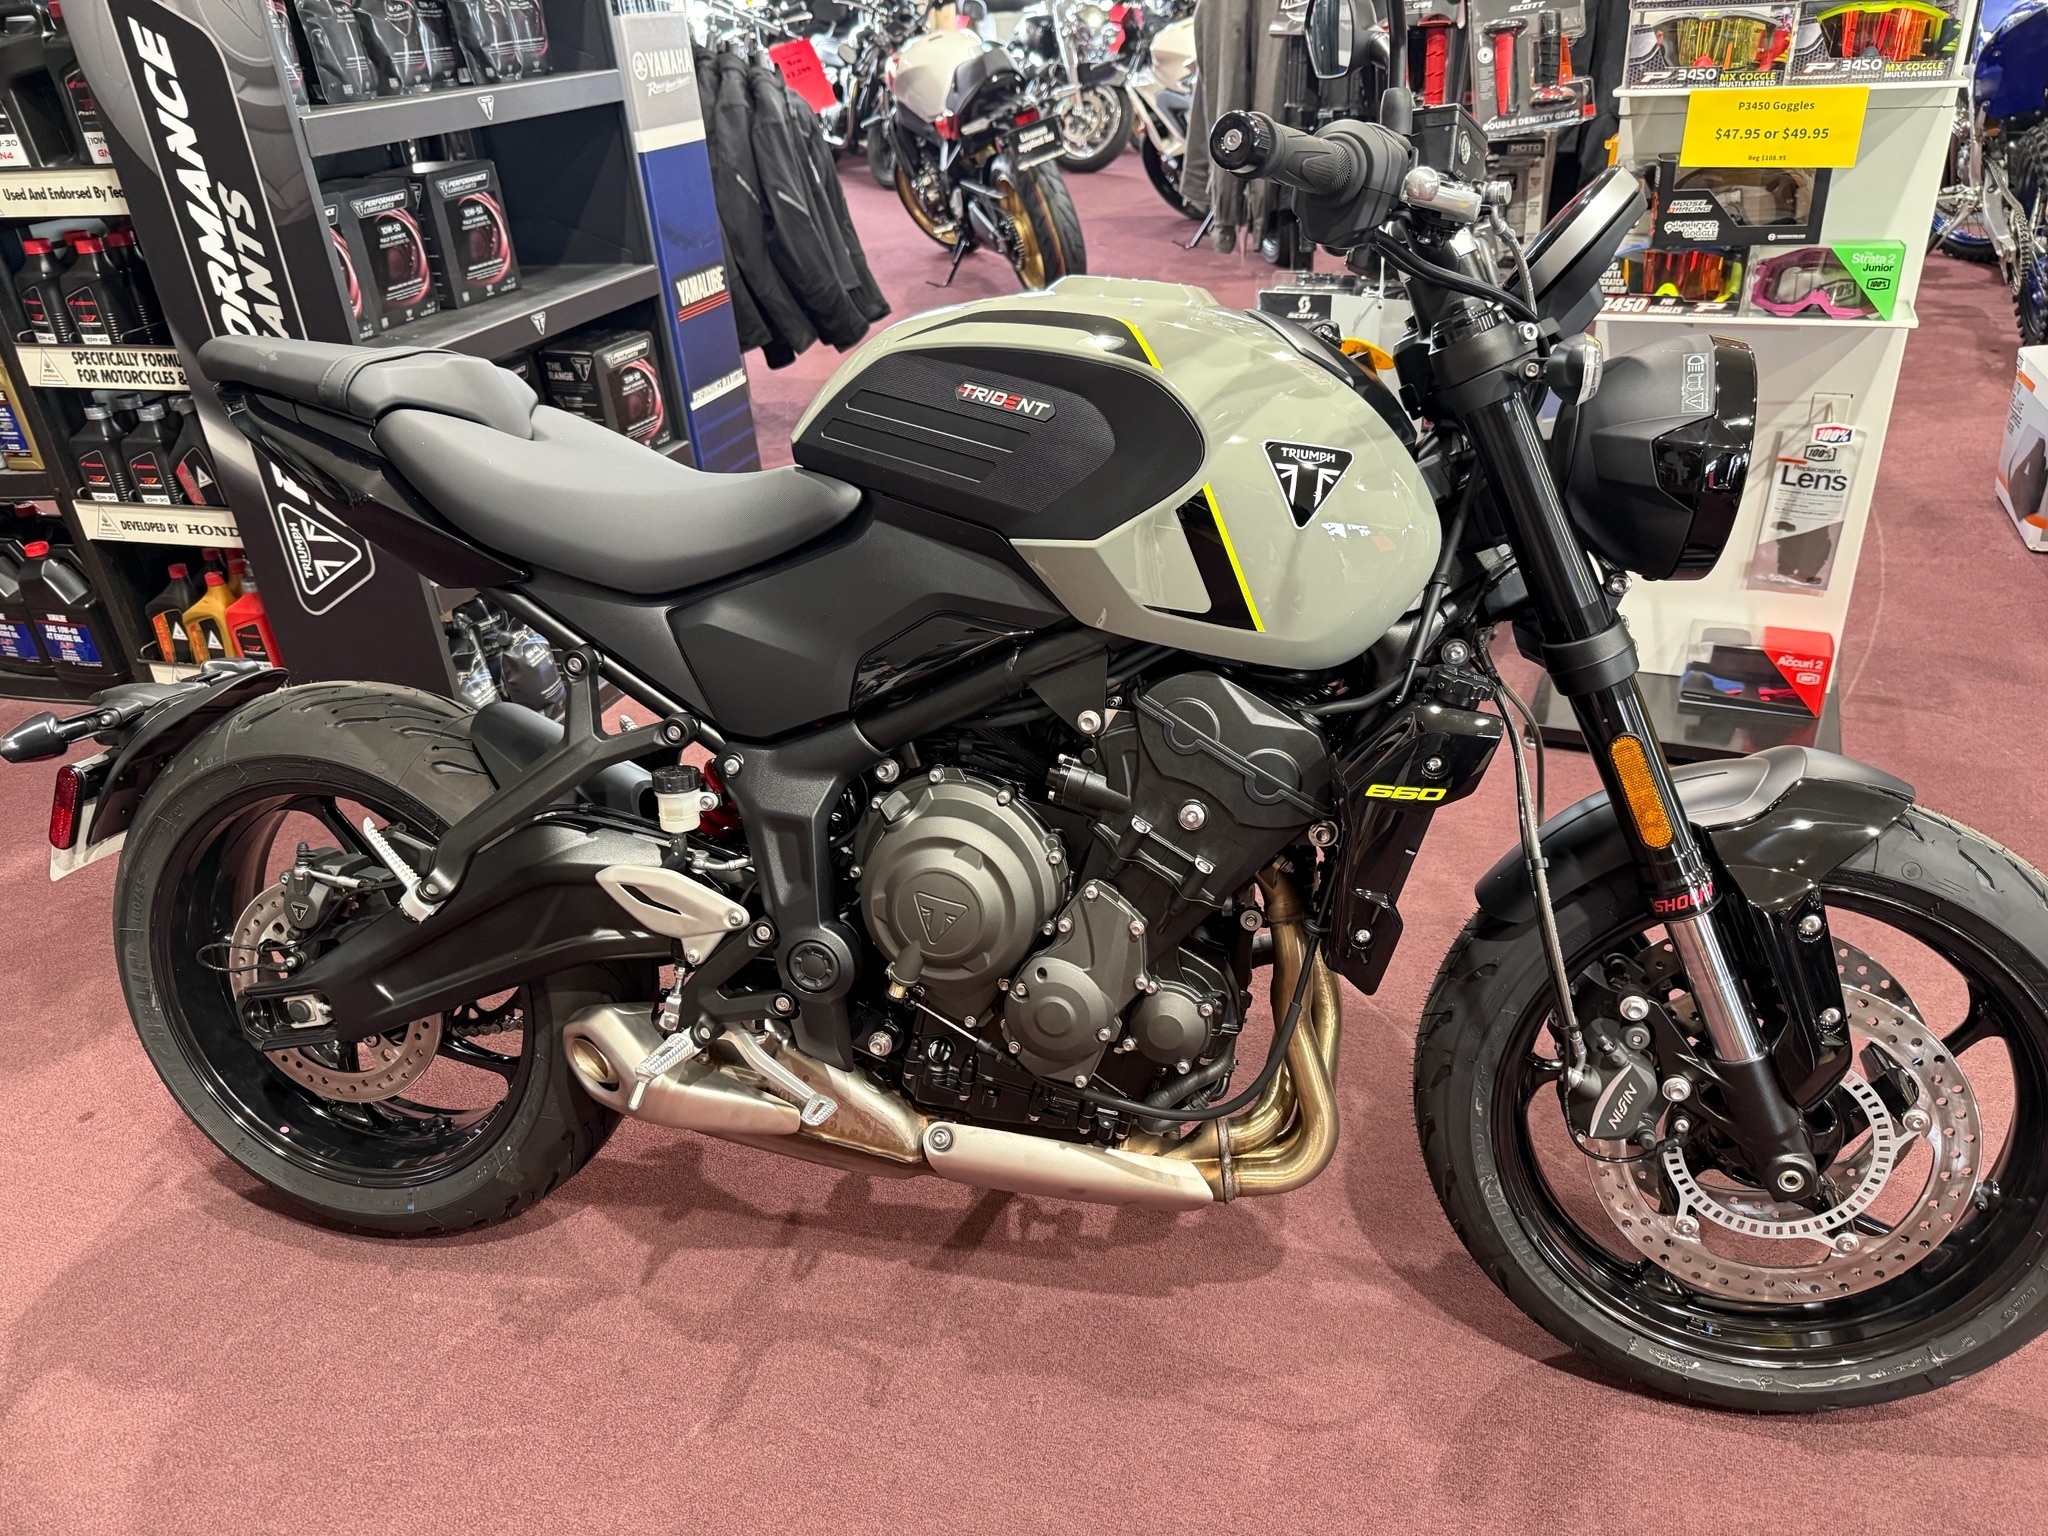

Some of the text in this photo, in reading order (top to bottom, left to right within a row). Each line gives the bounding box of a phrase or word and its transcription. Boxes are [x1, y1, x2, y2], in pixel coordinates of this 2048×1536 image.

[1509, 1, 1546, 12] SCOTT
[644, 47, 693, 78] YAMAHA
[1841, 58, 1883, 71] 3450
[1885, 62, 1944, 71] MX GOGGLE
[1677, 68, 1717, 80] 3450
[1719, 72, 1776, 81] MX GOGGLE
[1884, 70, 1943, 78] MULTILAYERED
[1738, 101, 1815, 112] P3450 Goggles
[1482, 109, 1580, 132] DOUBLE DENSITY GRIPS
[1715, 127, 1829, 141] $47.95 or $49.95
[1510, 144, 1540, 153] MOTO
[3, 188, 26, 201] Used
[29, 187, 47, 200] And
[49, 186, 93, 200] Endorsed
[93, 186, 107, 202] By
[1683, 230, 1718, 238] GOGGLE
[1852, 253, 1897, 264] Strata 2
[1862, 263, 1894, 273] Junior
[675, 265, 726, 307] YAMALUBE
[1286, 312, 1319, 320] SCOTT
[72, 351, 140, 367] SPECIFICALLY
[546, 361, 563, 372] THE
[77, 369, 188, 385] FOR MOTORCYCLES &
[547, 372, 575, 382] RANGE
[961, 383, 1051, 416] TRIDENT
[1817, 428, 1850, 442] 100%
[1281, 447, 1336, 463] TRIUMPH
[1794, 464, 1842, 474] Replacement
[1780, 465, 1848, 491] Lens
[120, 520, 241, 537] DEVELOPED BY HOND
[288, 522, 314, 579] TRIUMPH
[1777, 656, 1825, 669] Accuri 2
[1365, 784, 1447, 801] 660
